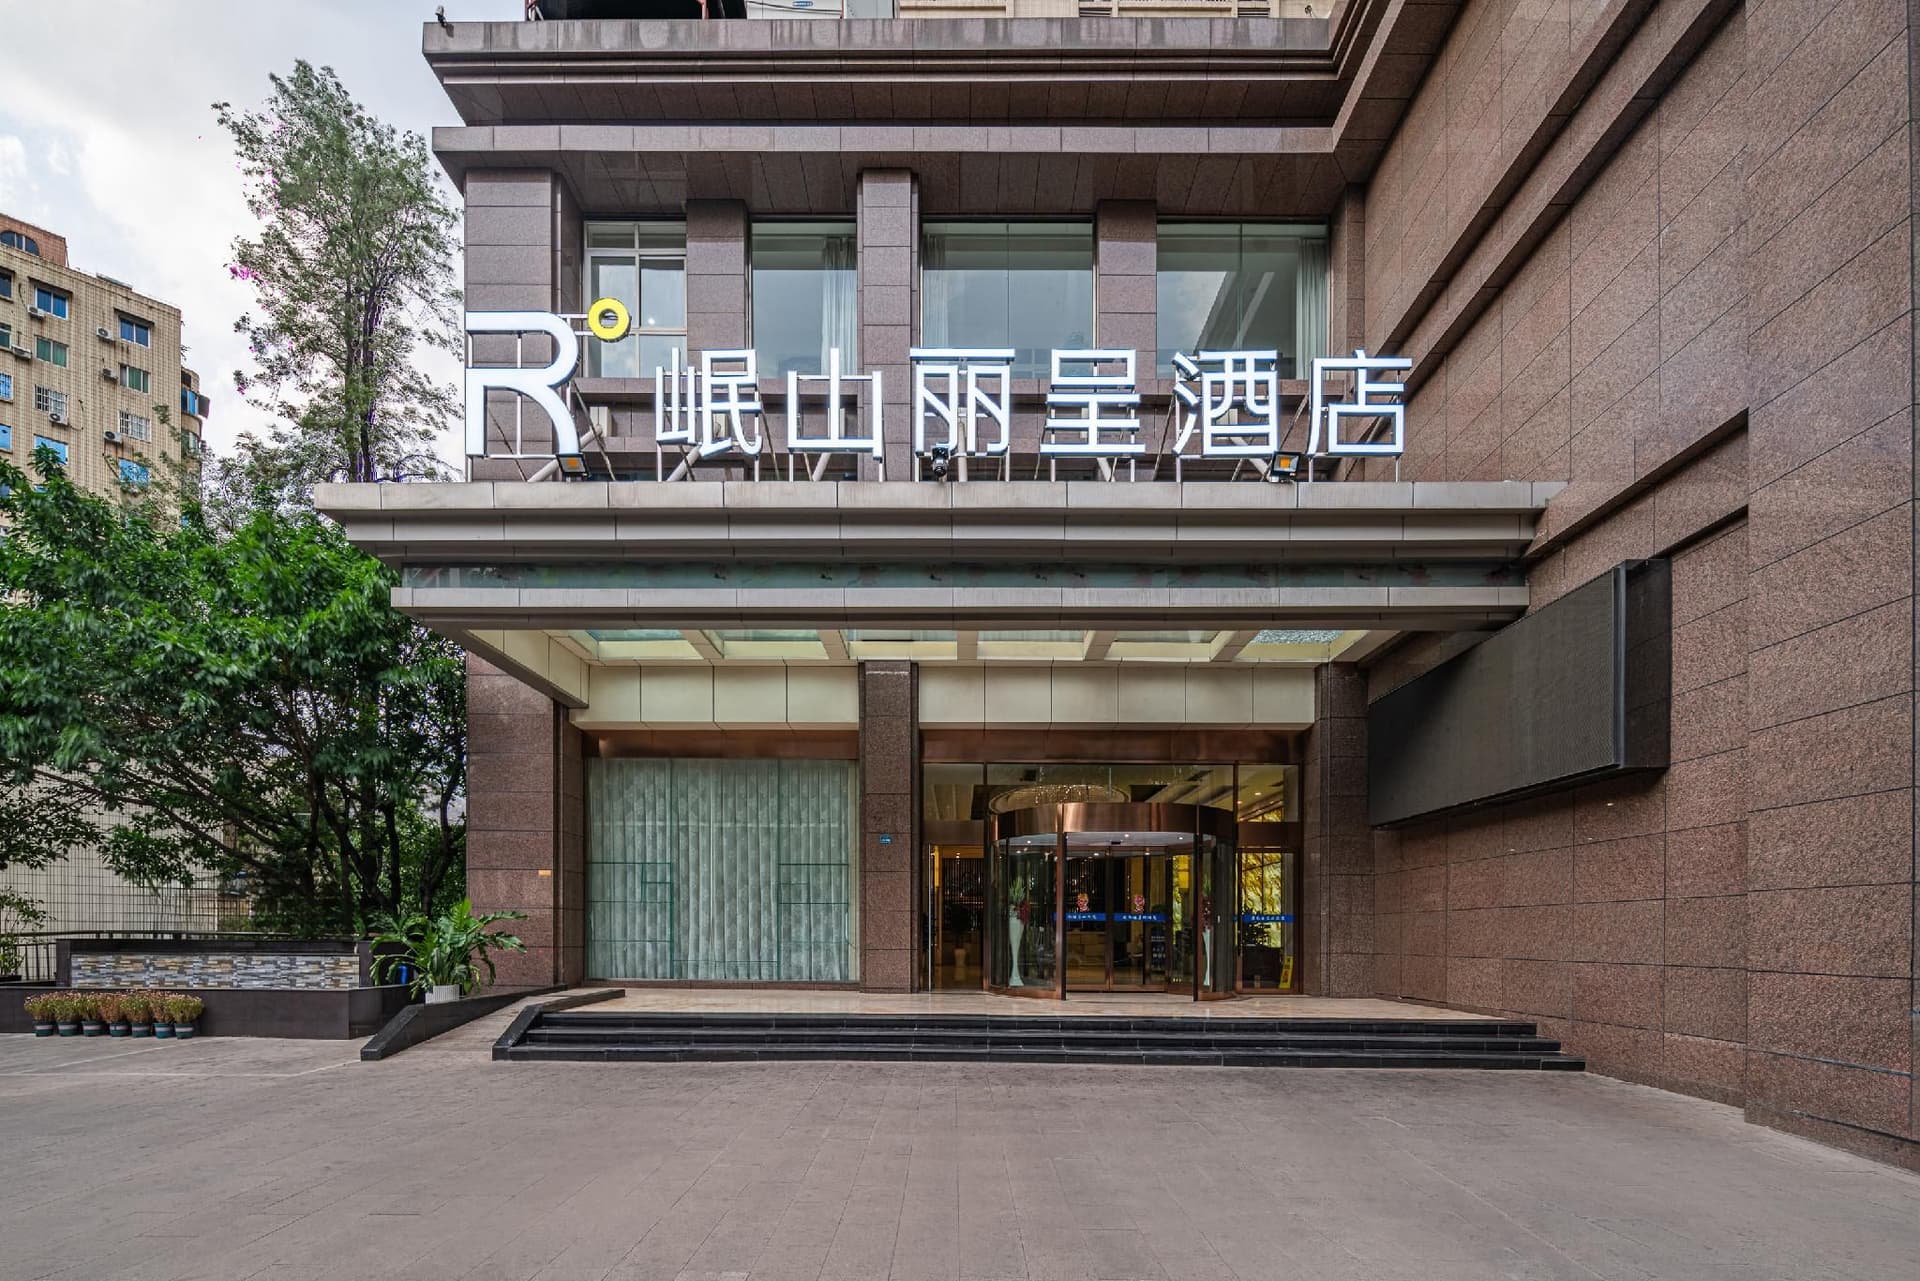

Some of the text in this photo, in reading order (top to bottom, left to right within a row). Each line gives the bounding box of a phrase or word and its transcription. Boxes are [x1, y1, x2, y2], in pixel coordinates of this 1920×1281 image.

[655, 347, 1413, 461] 岷山丽呈酒店
